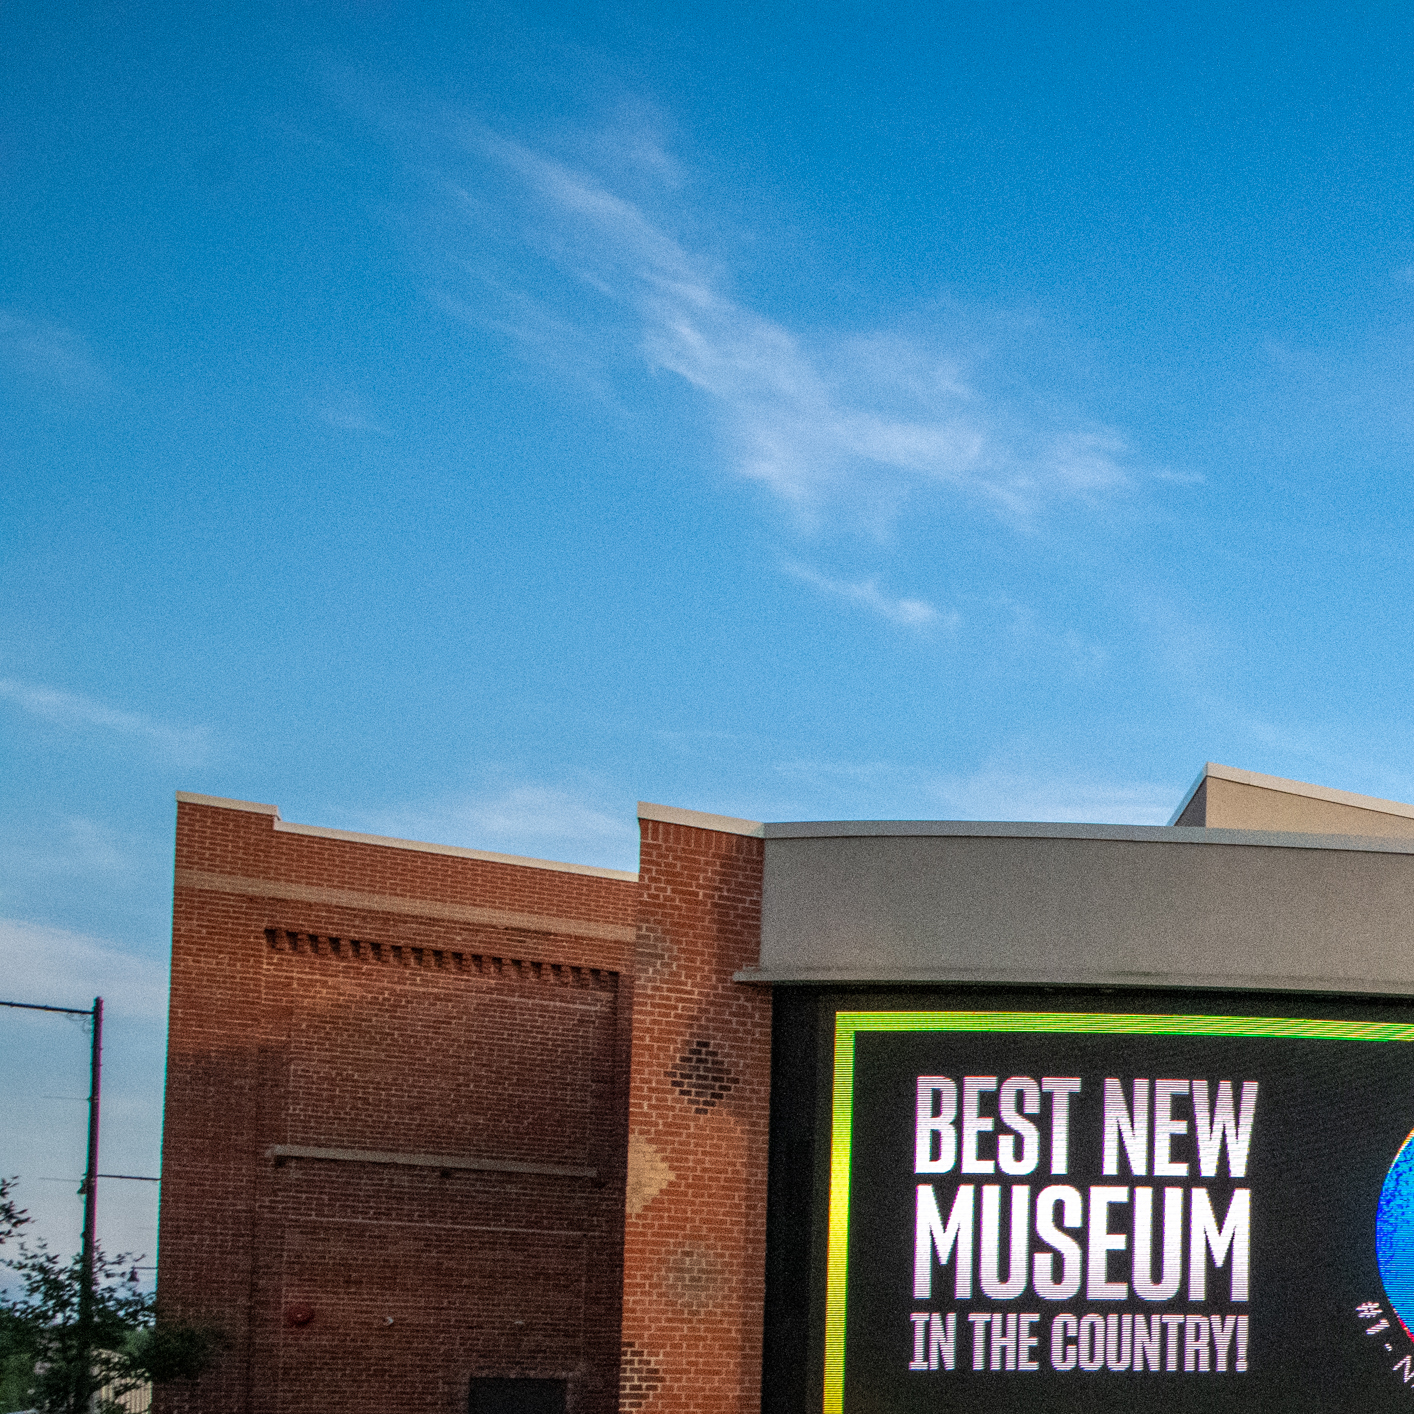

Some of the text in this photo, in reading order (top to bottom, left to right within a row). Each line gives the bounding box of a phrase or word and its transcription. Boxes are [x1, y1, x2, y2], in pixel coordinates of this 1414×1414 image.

[913, 1075, 1259, 1178] BEST NEW
[913, 1184, 1251, 1302] MUSEUM
[909, 1313, 1250, 1372] IN THE COUNTRY!
[1355, 1301, 1391, 1335] #1
